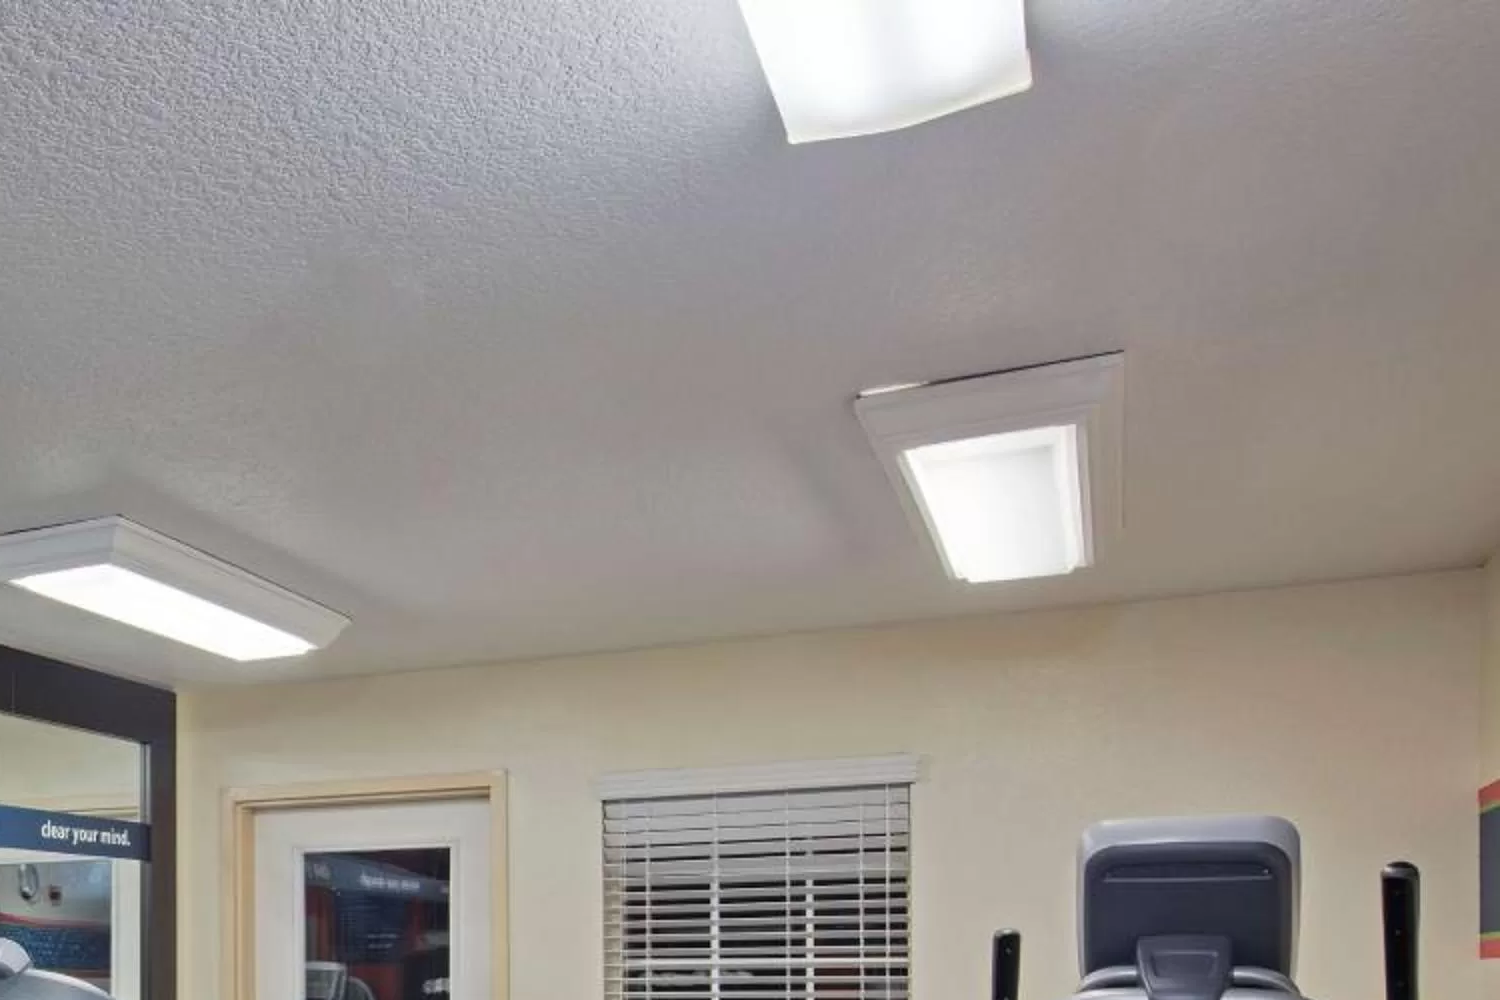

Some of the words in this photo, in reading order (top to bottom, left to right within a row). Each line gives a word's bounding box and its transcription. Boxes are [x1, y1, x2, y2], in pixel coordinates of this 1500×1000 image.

[41, 819, 71, 840] clear
[71, 825, 100, 846] your
[99, 827, 132, 847] mind.
